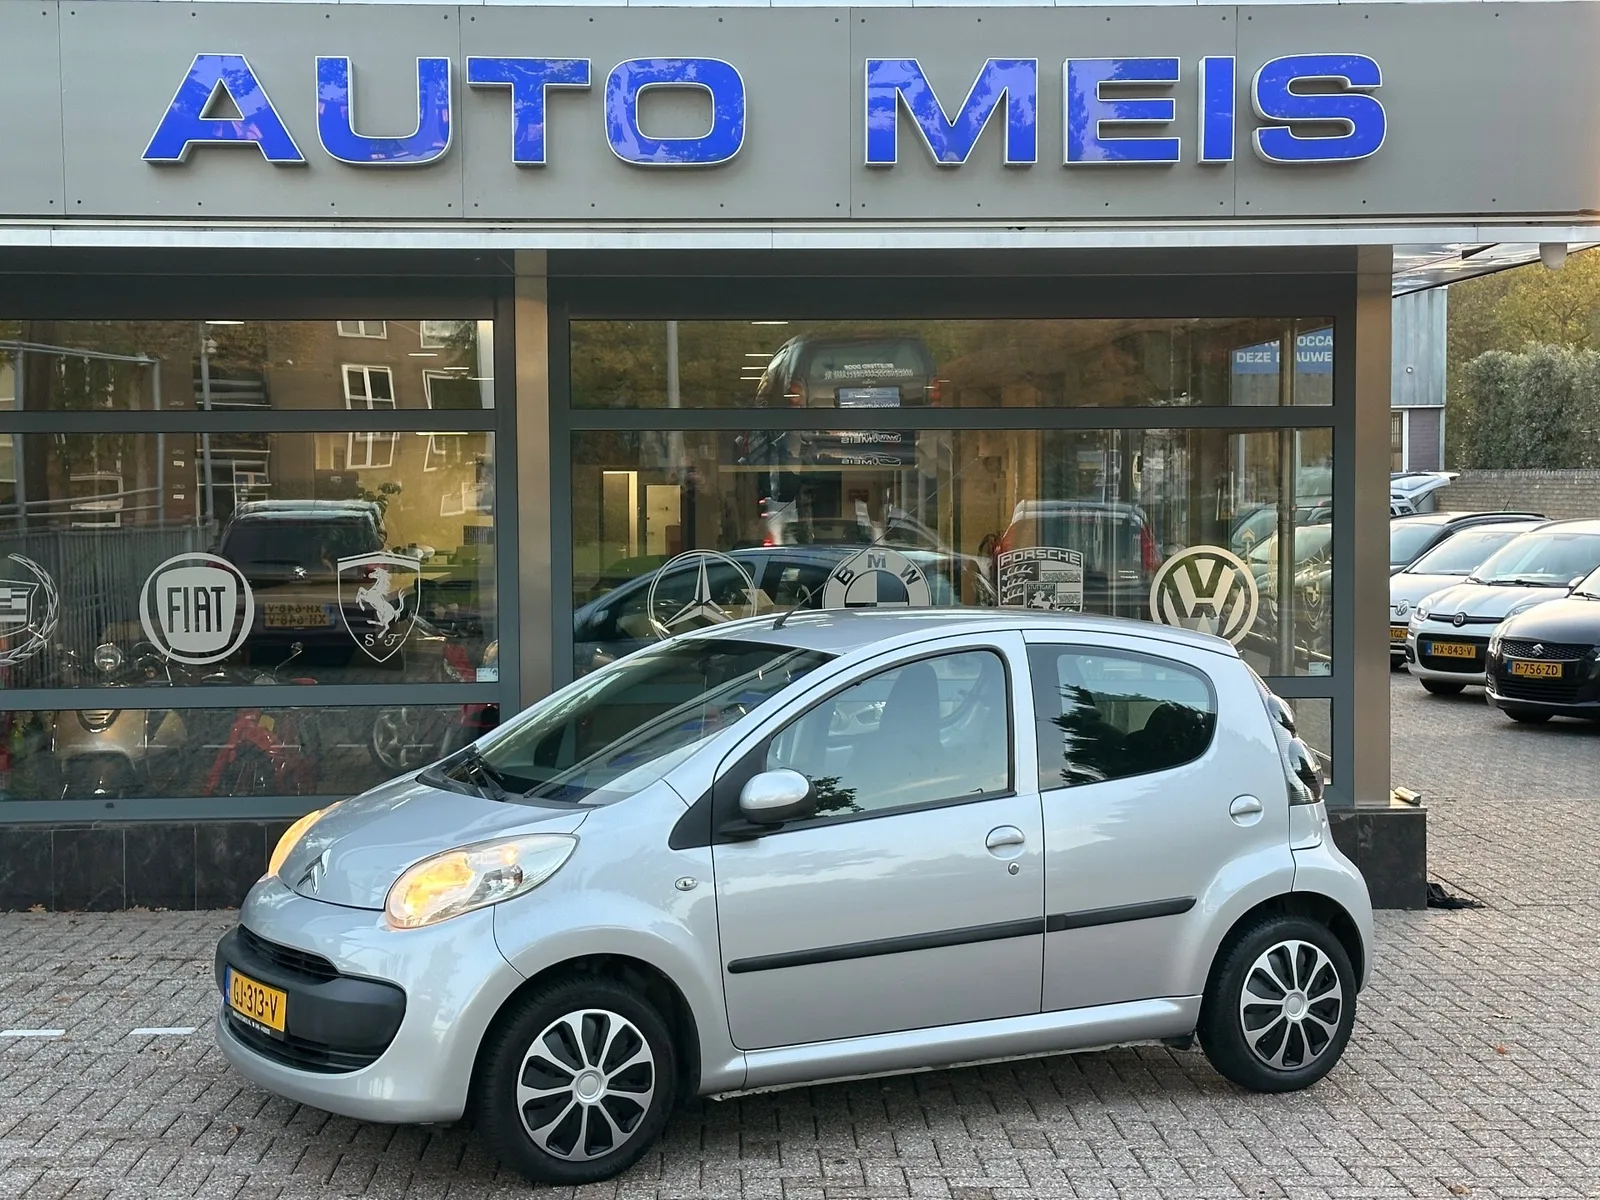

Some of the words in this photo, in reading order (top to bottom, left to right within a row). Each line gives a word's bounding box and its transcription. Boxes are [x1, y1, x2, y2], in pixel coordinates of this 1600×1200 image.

[141, 52, 747, 168] AUTO
[864, 52, 1388, 167] MEIS
[1236, 352, 1271, 363] DEZE
[1001, 549, 1080, 567] PORSCHE
[833, 553, 921, 588] BMW
[1027, 583, 1055, 591] STUTTGART
[166, 586, 226, 633] FIAT
[364, 633, 375, 647] S
[1433, 644, 1473, 657] HX-843-V
[1514, 662, 1559, 676] P-756-ZD
[233, 977, 279, 1023] GJ-313-V
